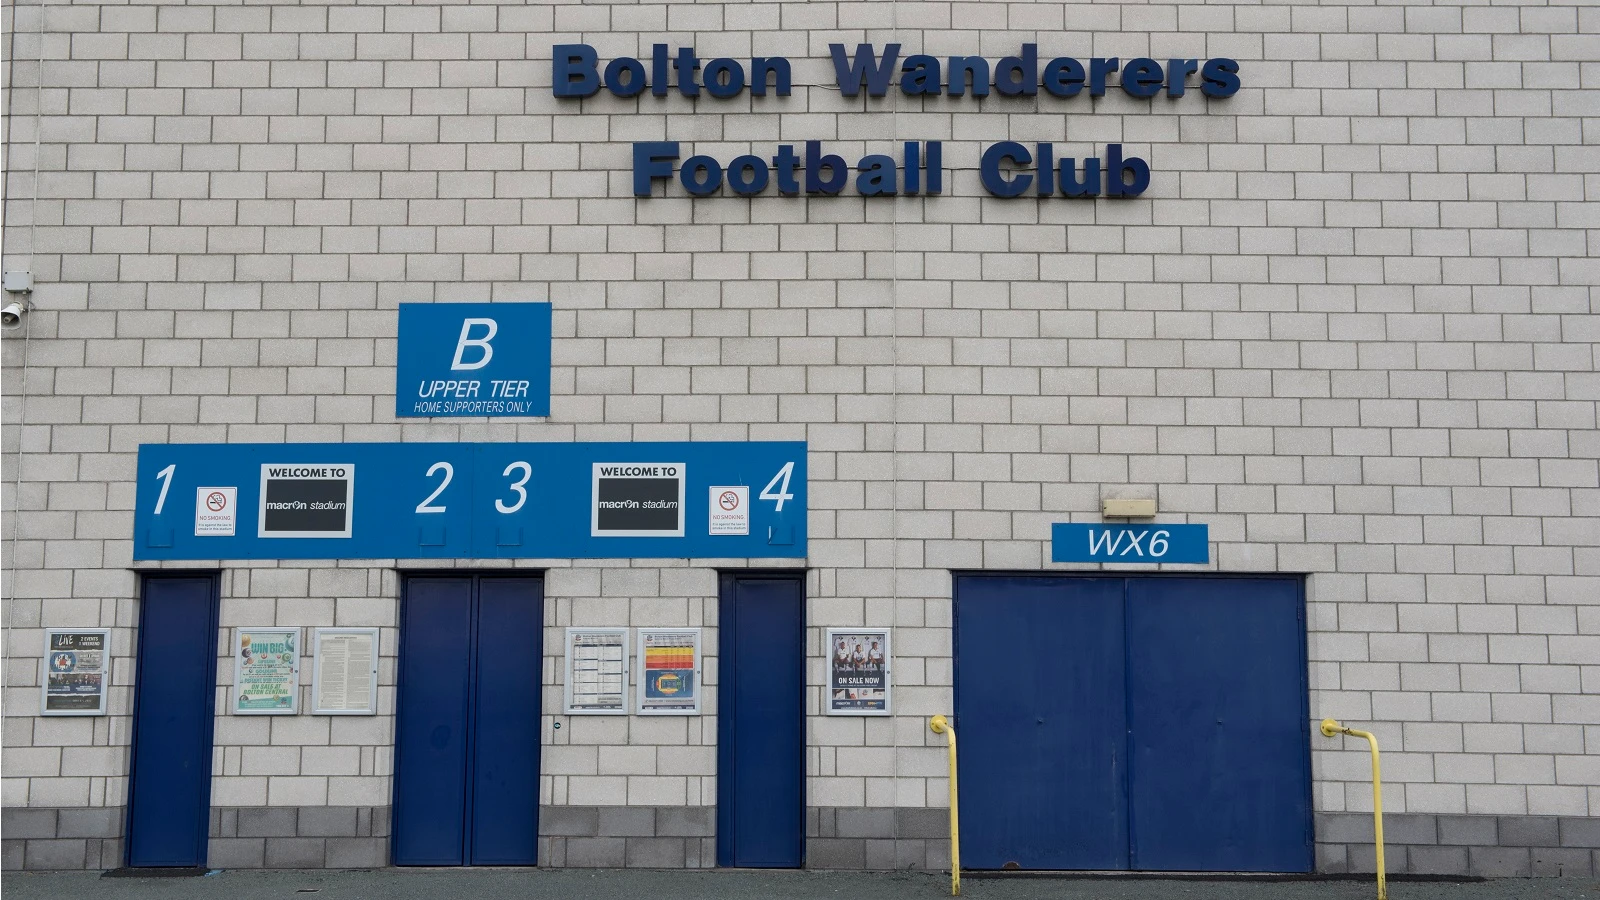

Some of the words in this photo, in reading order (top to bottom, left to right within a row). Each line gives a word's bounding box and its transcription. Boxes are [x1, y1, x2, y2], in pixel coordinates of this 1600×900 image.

[552, 43, 792, 99] Bolton
[828, 43, 1242, 100] Wanderers
[633, 140, 942, 197] Football
[980, 141, 1150, 198] Club
[451, 318, 498, 371] B
[418, 380, 480, 398] UPPER
[490, 380, 530, 398] TIER
[414, 401, 442, 413] HOME
[443, 401, 505, 413] SUPPORTERS
[506, 401, 533, 413] ONLY
[269, 468, 327, 478] WELCOME
[330, 468, 346, 478] TO
[600, 467, 659, 476] WELCOME
[661, 467, 677, 476] TO
[154, 464, 176, 515] 1
[415, 461, 454, 514] 2
[495, 461, 532, 514] 3
[759, 461, 795, 512] 4
[266, 500, 307, 510] macron
[309, 500, 346, 510] stadium
[599, 499, 640, 509] macron
[642, 499, 678, 509] stadium
[1088, 529, 1170, 557] WX6
[251, 643, 268, 654] WIN
[270, 643, 284, 654] BIG
